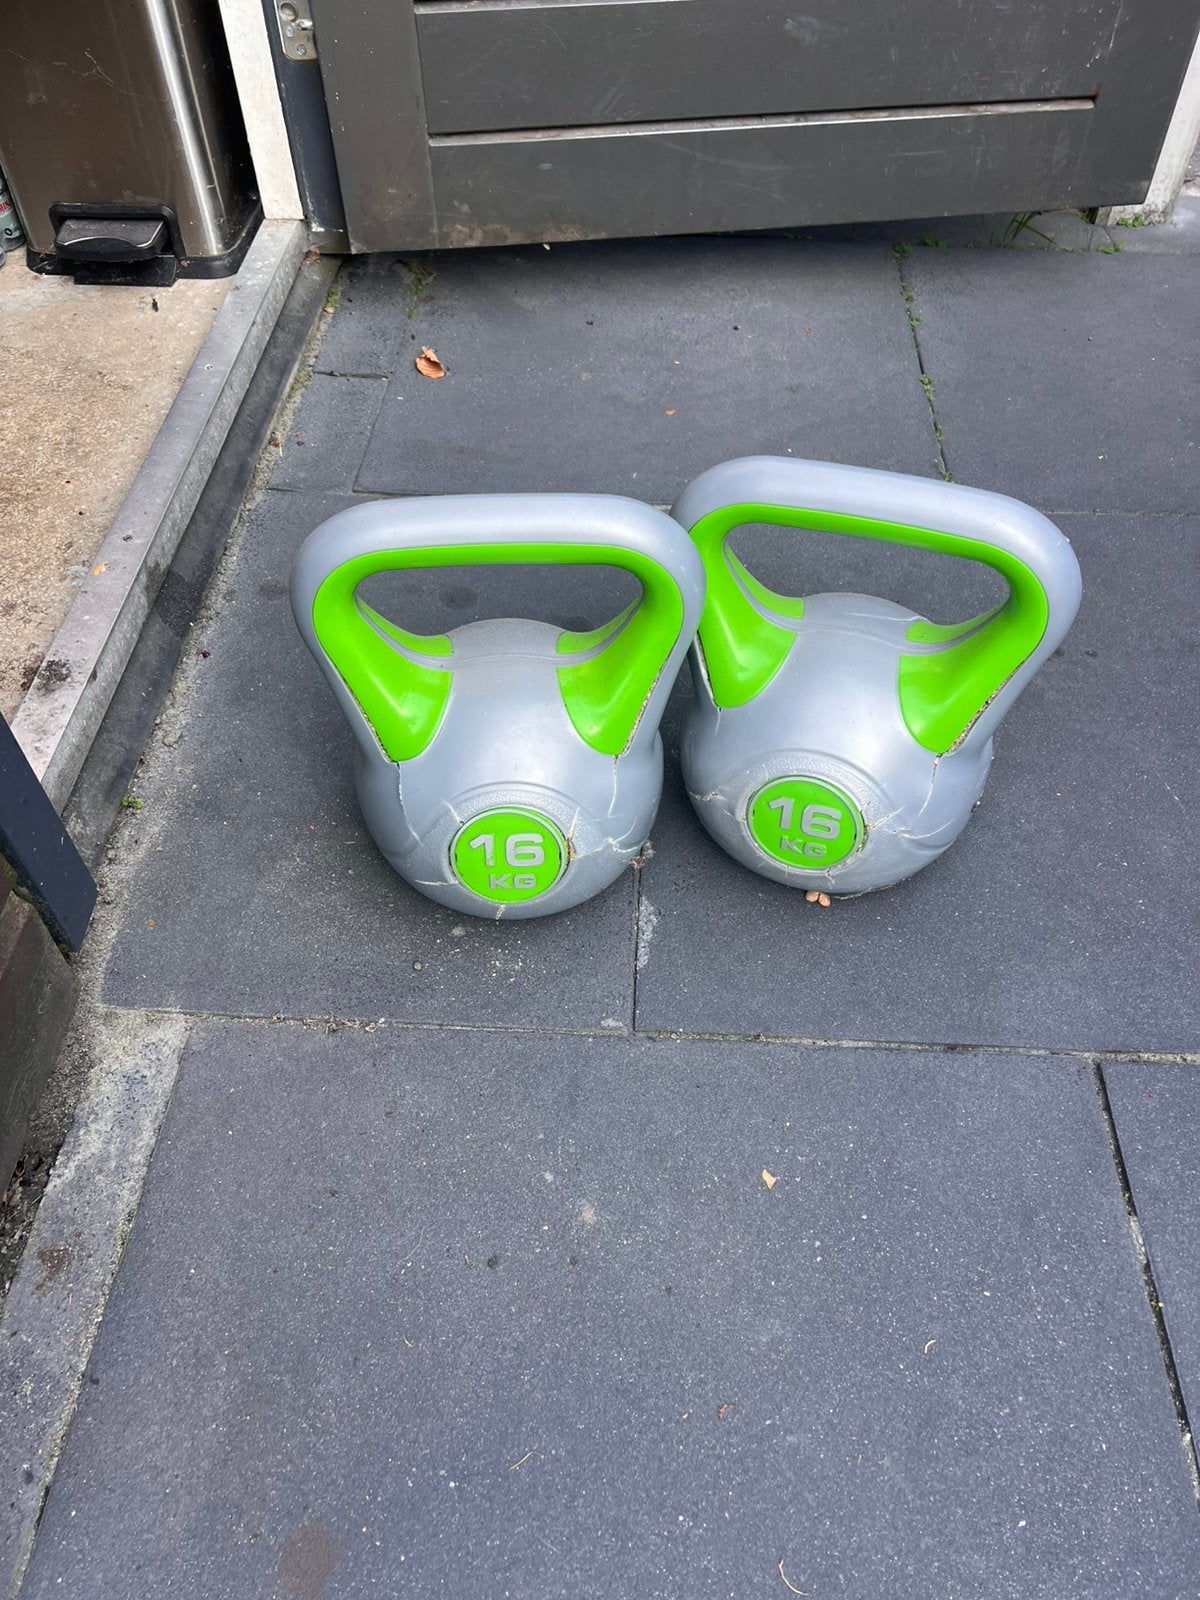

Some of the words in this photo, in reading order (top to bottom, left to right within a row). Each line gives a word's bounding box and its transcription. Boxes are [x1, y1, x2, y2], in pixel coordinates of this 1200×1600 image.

[768, 796, 842, 839] 16
[469, 833, 545, 867] 16
[780, 835, 827, 858] KG
[489, 873, 537, 890] KG
